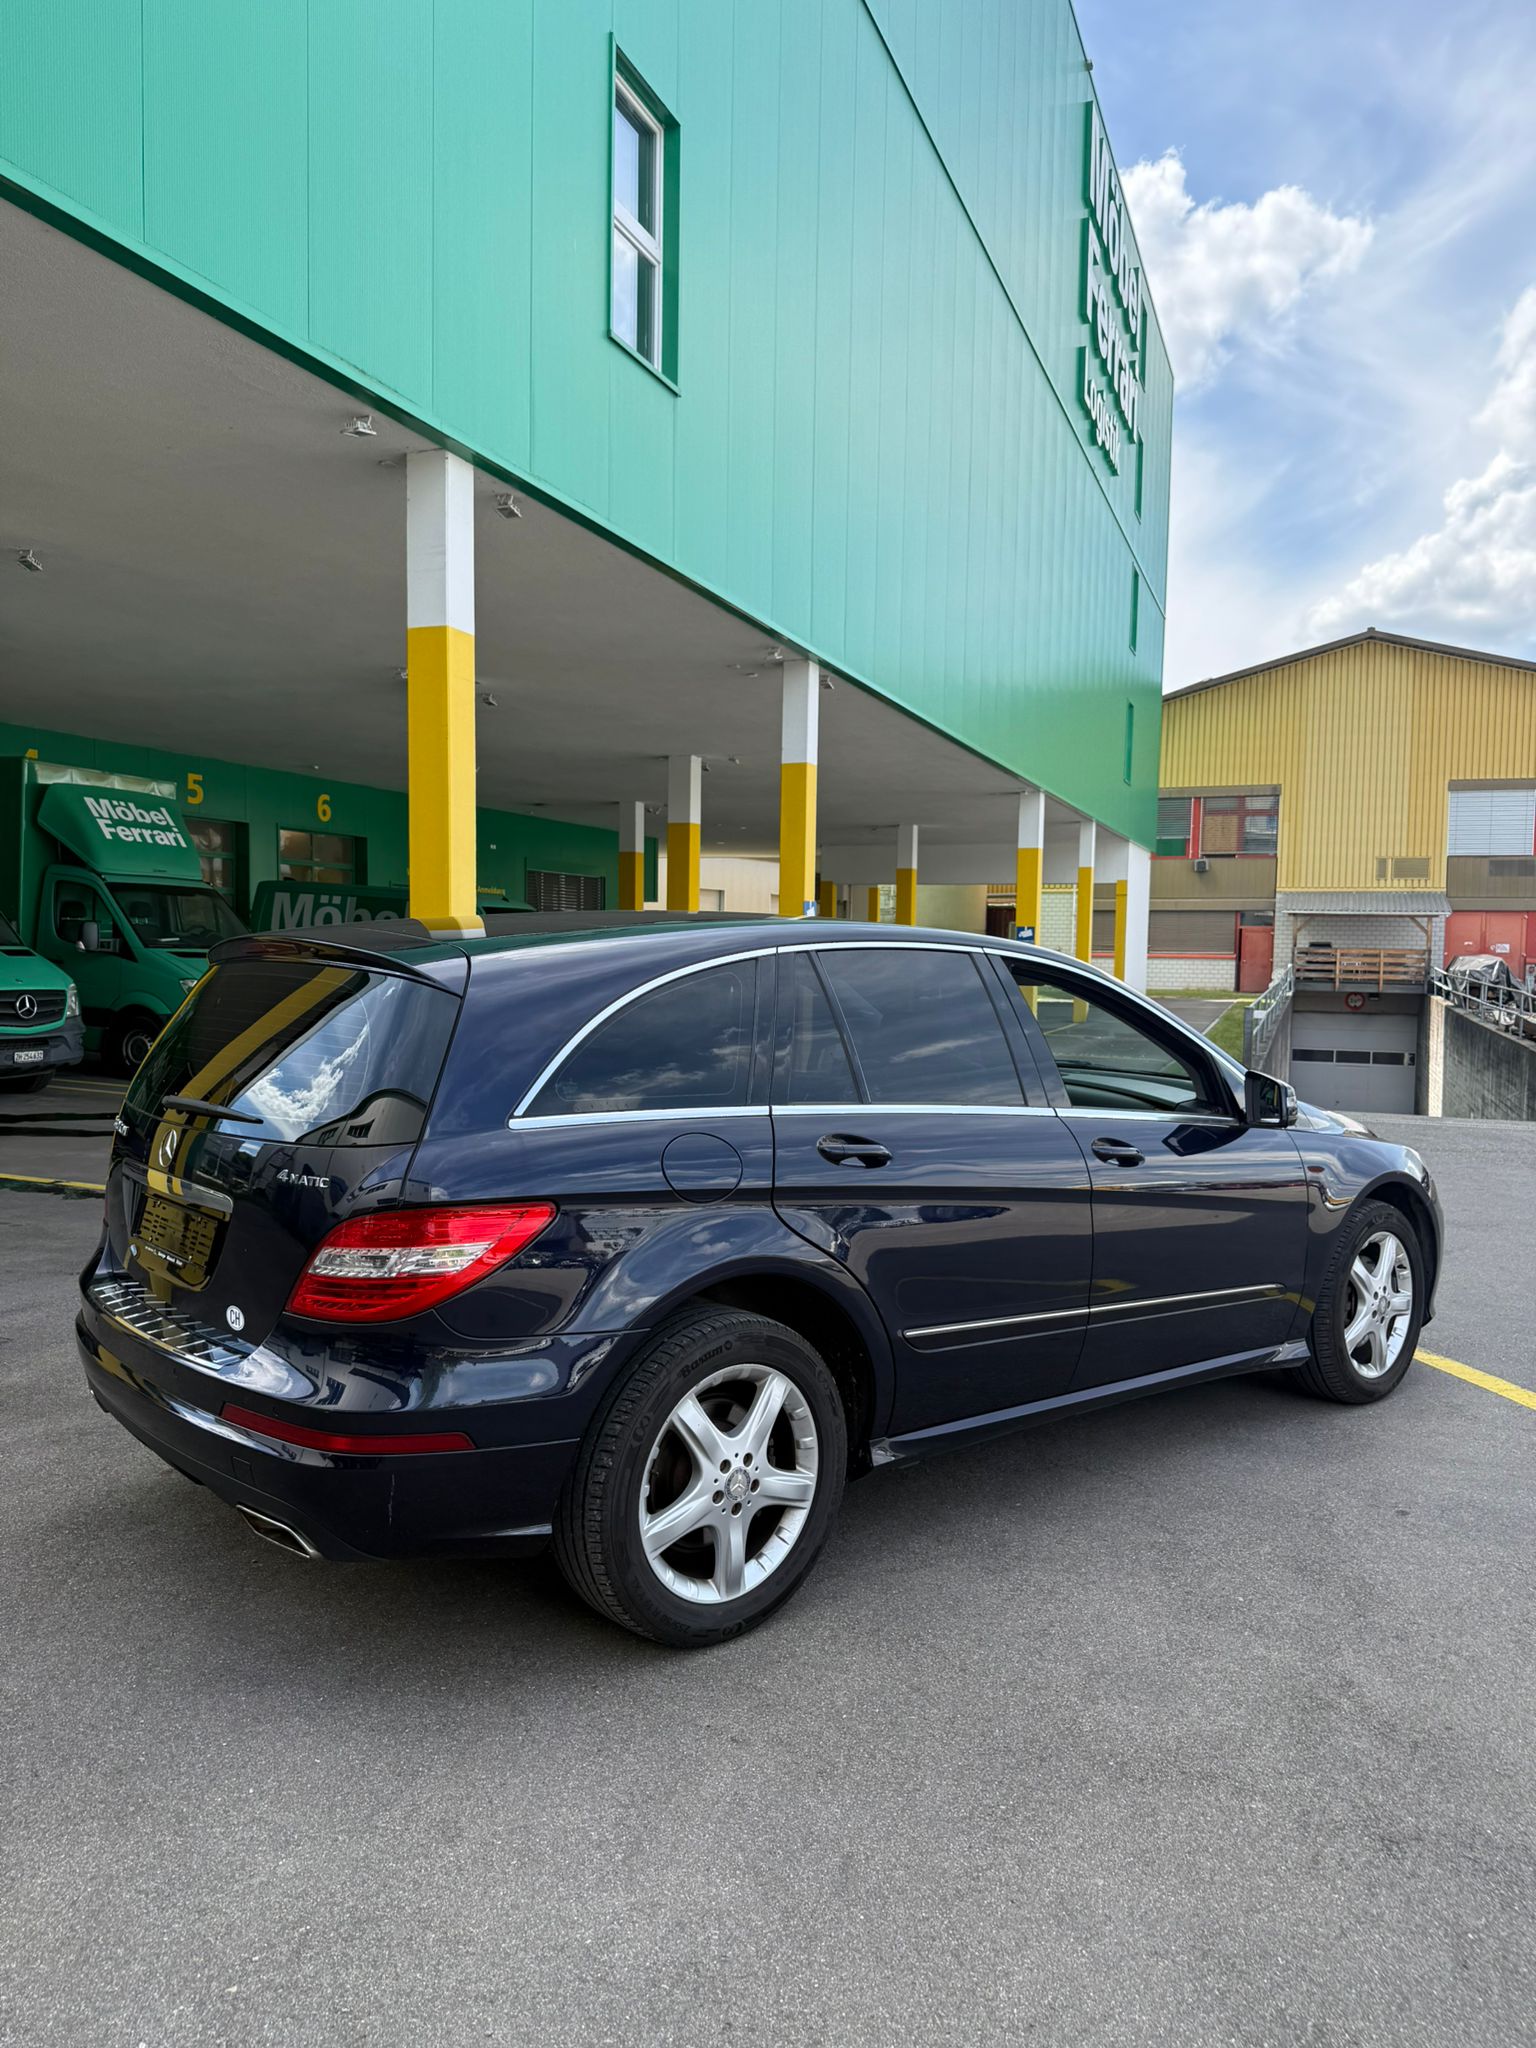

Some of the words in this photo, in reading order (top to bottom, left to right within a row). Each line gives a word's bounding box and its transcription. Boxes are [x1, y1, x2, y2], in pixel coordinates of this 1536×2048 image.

[1089, 101, 1141, 352] Möbel
[1086, 217, 1139, 443] Ferrari
[1084, 346, 1120, 476] Logistik
[187, 773, 204, 804] 5
[83, 796, 176, 827] Möbel
[317, 794, 332, 822] 6
[96, 818, 187, 848] Ferrari
[271, 891, 409, 931] Möb
[276, 1169, 330, 1188] 4MATIC
[230, 1309, 241, 1327] CH
